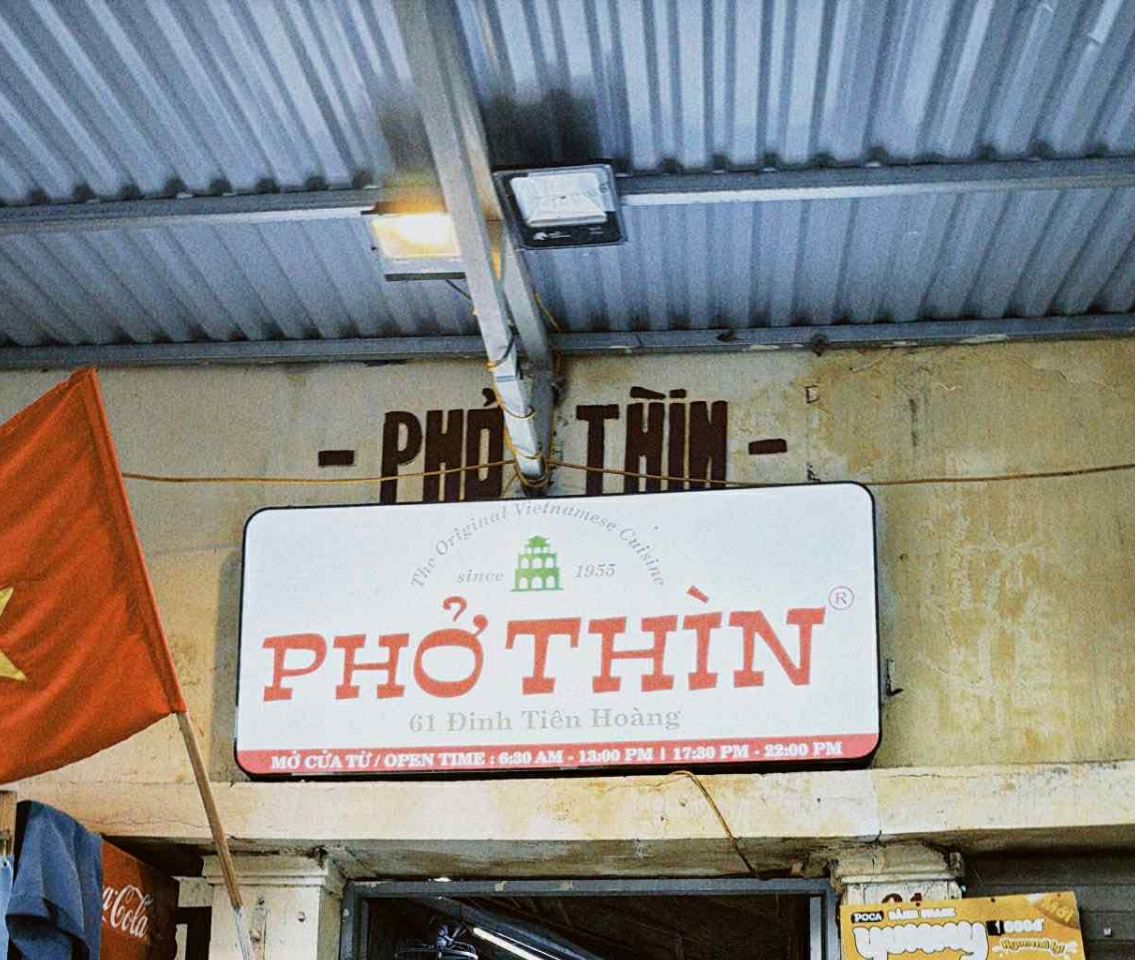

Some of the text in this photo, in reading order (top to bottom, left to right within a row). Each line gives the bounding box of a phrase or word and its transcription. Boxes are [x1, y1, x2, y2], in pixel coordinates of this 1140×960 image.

[410, 501, 665, 590] The Original Vietnamese Cuisine
[456, 563, 616, 584] since 1955
[261, 595, 489, 702] PHỞ
[505, 586, 826, 696] THÌN
[409, 713, 435, 733] 61
[521, 709, 581, 731] Tiên
[591, 706, 682, 731] Hoàng
[383, 753, 434, 768] OPEN
[438, 751, 485, 767] TIME
[499, 750, 532, 765] 6:30
[534, 749, 563, 764] AM
[578, 748, 620, 763] 13:00
[624, 747, 654, 762] PM
[673, 745, 716, 760] 17:30
[720, 744, 749, 759] PM
[764, 742, 809, 757] 22:00
[812, 741, 842, 756] PM
[854, 911, 883, 923] POCA
